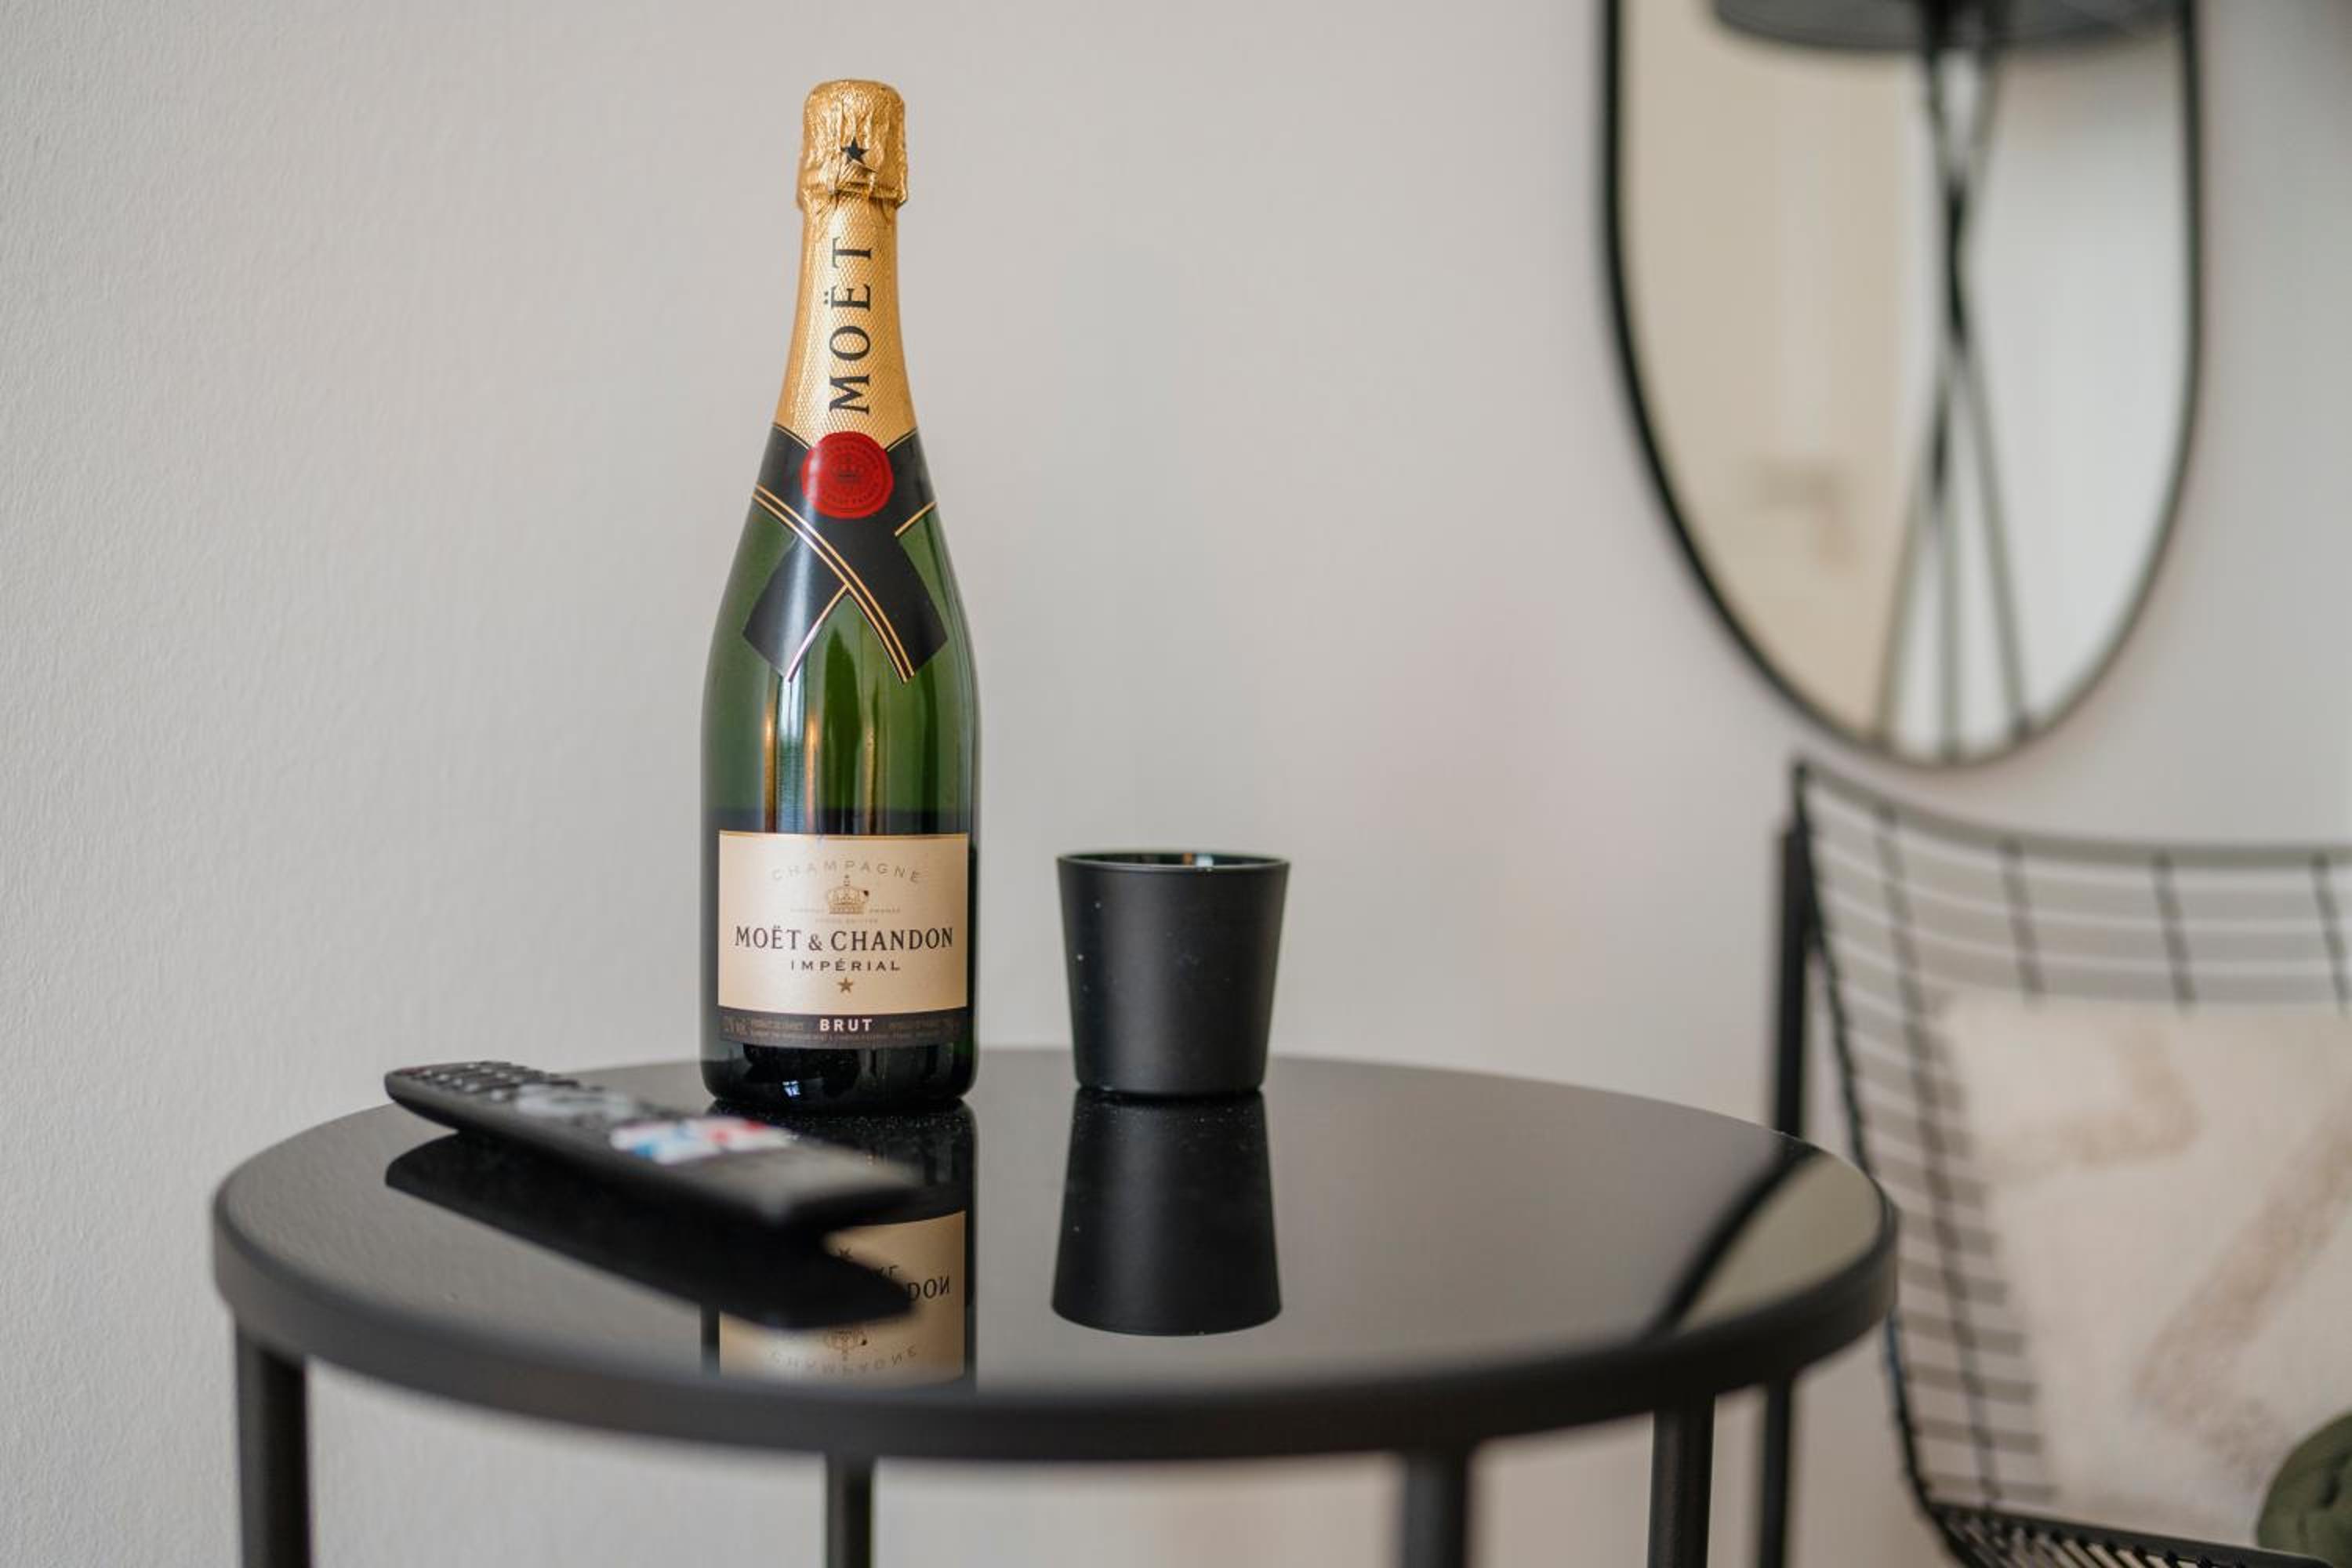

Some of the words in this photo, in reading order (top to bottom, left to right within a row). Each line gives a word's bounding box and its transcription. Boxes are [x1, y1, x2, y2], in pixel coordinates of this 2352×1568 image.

[824, 238, 872, 414] MOËT
[771, 860, 922, 884] CHAMPAGNE
[735, 925, 802, 949] MOËT
[808, 933, 823, 951] &
[830, 927, 953, 951] CHANDON
[790, 958, 901, 971] IMPÉRIAL
[819, 1018, 873, 1032] BRUT
